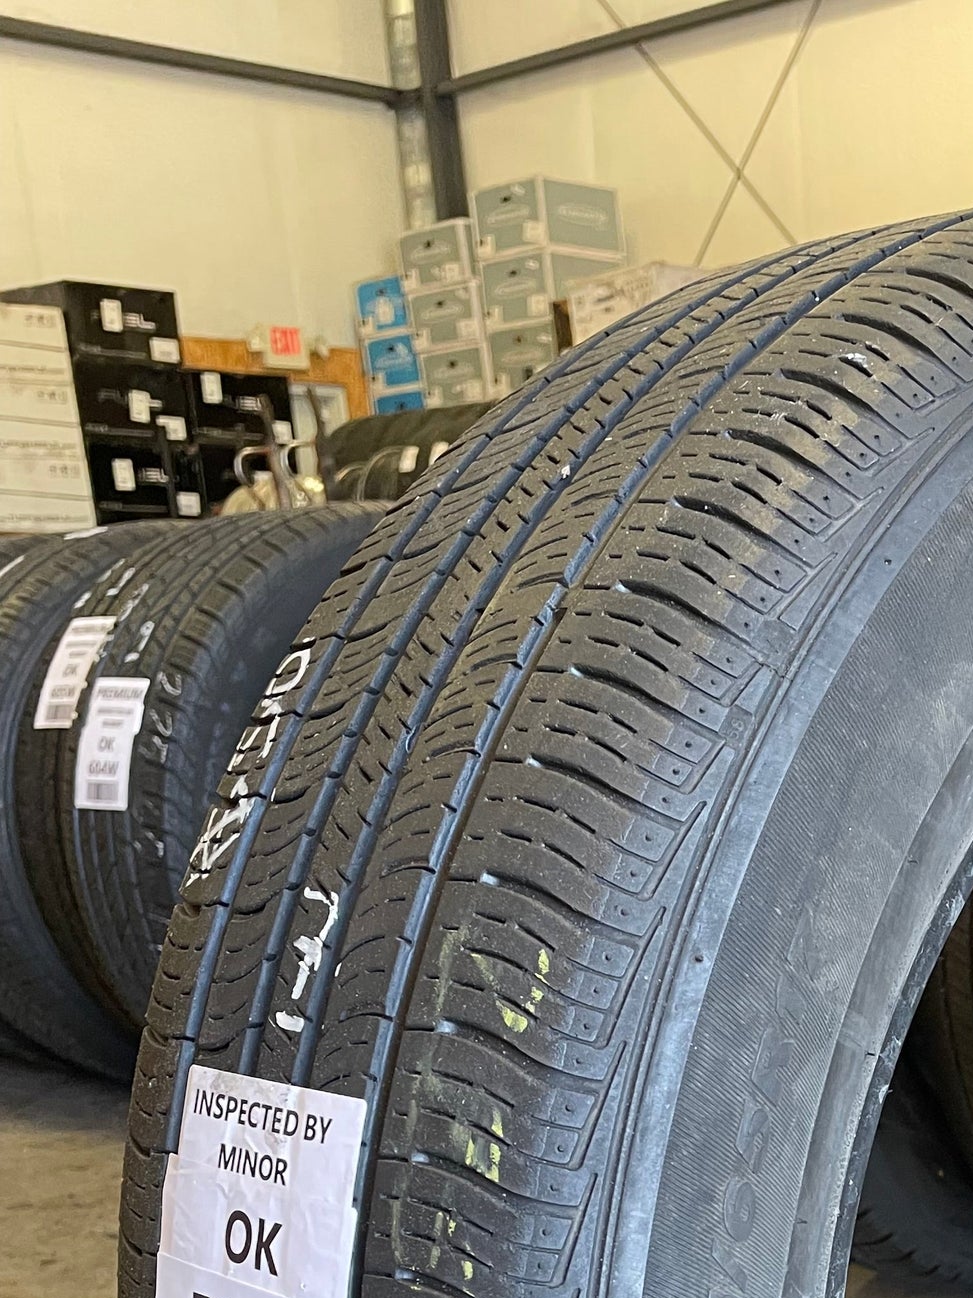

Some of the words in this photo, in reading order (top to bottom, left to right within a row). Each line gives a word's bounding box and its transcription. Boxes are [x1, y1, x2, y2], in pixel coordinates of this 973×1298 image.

[97, 736, 115, 751] OK
[193, 1087, 299, 1138] INSPECTED
[303, 1113, 333, 1144] BY
[217, 1143, 288, 1187] MINOR
[224, 1209, 283, 1278] OK
